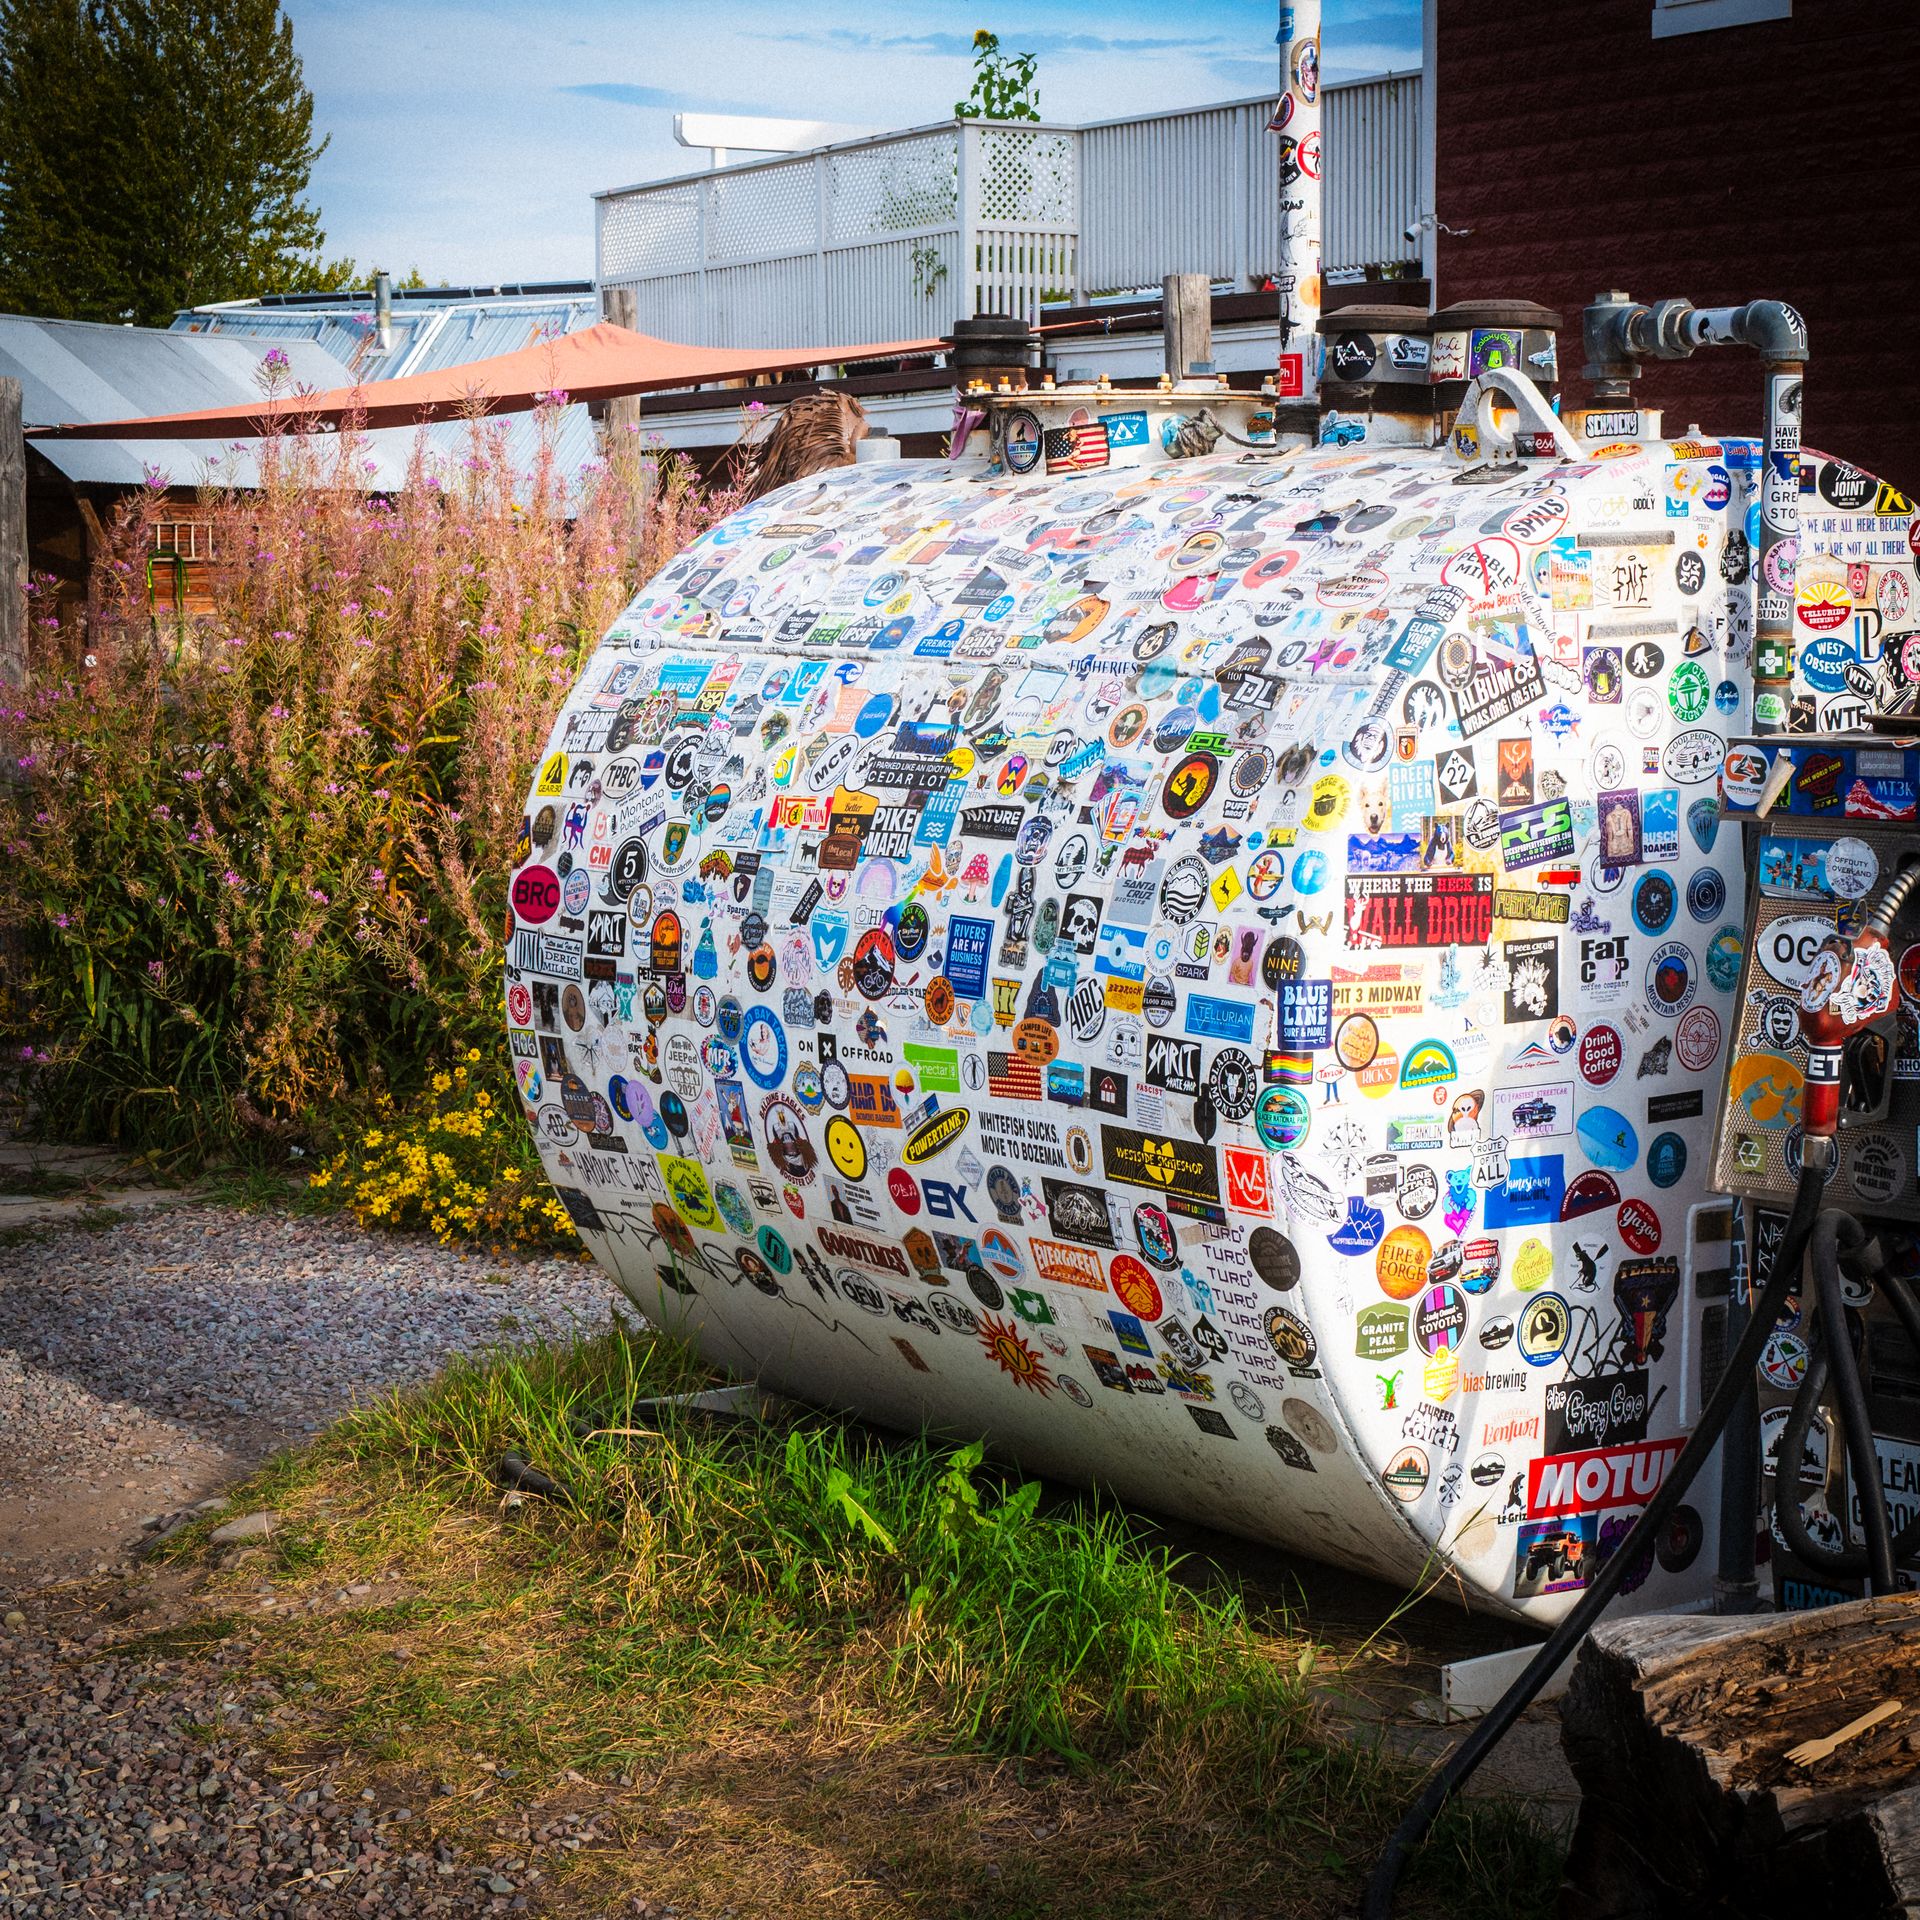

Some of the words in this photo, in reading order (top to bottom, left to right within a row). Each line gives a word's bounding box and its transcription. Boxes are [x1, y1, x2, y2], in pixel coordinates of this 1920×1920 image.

[1775, 427, 1797, 438] HAVE
[1775, 438, 1797, 449] SEEN
[1675, 447, 1723, 460] ADVENTURES
[1835, 464, 1862, 481] The
[1831, 481, 1866, 497] JOINT
[1633, 498, 1655, 510] ODDLY
[1510, 498, 1565, 538] SPILLS
[1807, 520, 1819, 533] WE
[1821, 519, 1837, 533] ARE
[1841, 519, 1853, 533] ALL
[1856, 518, 1876, 532] HERE
[1879, 517, 1911, 532] BECAUSE
[1814, 543, 1825, 555] WE
[1829, 543, 1843, 556] ARE
[1865, 542, 1878, 555] ALL
[1882, 541, 1906, 555] THERE
[1802, 608, 1846, 618] TELLURIDE
[1409, 620, 1442, 637] ELOPE
[1407, 632, 1430, 647] YOUR
[1402, 644, 1424, 658] LIFE
[1817, 642, 1845, 657] WEST
[662, 679, 698, 693] WATERS
[1848, 670, 1873, 691] WTF
[1458, 668, 1513, 716] ALBUM
[1462, 700, 1509, 735] WRAS.ORG
[1529, 679, 1543, 697] FM
[1762, 697, 1775, 705] GO
[1756, 705, 1781, 715] TEAM
[1824, 707, 1866, 730] WTF
[1668, 734, 1688, 754] GOOD
[1689, 732, 1718, 746] PEOPLE
[813, 741, 852, 785] MCB
[876, 760, 900, 770] PARKED
[900, 763, 914, 771] LIKE
[915, 764, 924, 772] AN
[925, 765, 943, 773] IDIOT
[943, 766, 953, 774] IN
[607, 764, 638, 788] TPBC
[868, 772, 913, 785] CEDAR
[919, 775, 947, 787] LOT
[1392, 766, 1433, 782] GREEN
[1446, 765, 1468, 787] 22
[537, 784, 562, 793] GEAR30
[1392, 782, 1432, 799] RIVER
[620, 789, 665, 820] Montana
[926, 796, 960, 813] RIVER
[620, 814, 641, 834] Public
[642, 802, 665, 820] Radio
[875, 808, 916, 830] PIKE
[966, 808, 1021, 825] NATURE
[865, 833, 912, 857] MAFIA
[1643, 831, 1677, 843] BUSCH
[590, 846, 611, 864] CM
[1643, 843, 1678, 853] ROAMER
[623, 848, 639, 877] 5
[1832, 866, 1872, 878] OVERLAND
[515, 881, 559, 902] BRC
[1122, 879, 1156, 891] SANTA
[1346, 878, 1400, 894] WHERE
[1405, 878, 1432, 892] THE
[1437, 877, 1473, 892] HECK
[1478, 877, 1492, 892] IS
[1126, 890, 1154, 900] CRUZ
[727, 905, 749, 916] Spargo
[589, 913, 621, 944] SPIRIT
[1427, 896, 1493, 944] DRUG
[954, 923, 986, 939] RIVERS
[952, 941, 969, 950] ARE
[972, 943, 984, 953] MY
[1653, 948, 1668, 966] SAN
[1669, 943, 1689, 960] DIEGO
[1773, 933, 1818, 967] OG
[544, 952, 577, 965] DERIC
[951, 953, 982, 965] BUSINESS
[1267, 959, 1298, 972] NINE
[543, 961, 579, 977] MILLER
[1176, 965, 1206, 978] SPARK
[1283, 985, 1328, 1005] BLUE
[1333, 989, 1351, 1005] PIT
[1356, 989, 1363, 1003] 3
[1369, 986, 1422, 1003] MIDWAY
[1647, 984, 1675, 1014] MOUNTAIN
[1676, 979, 1696, 1011] RESCUE
[1199, 1005, 1251, 1025] TELLURIAN
[1283, 1006, 1327, 1026] LINE
[1284, 1027, 1299, 1037] SURF
[1307, 1028, 1326, 1037] PADDLE
[1585, 1032, 1614, 1048] Drink
[513, 1033, 537, 1055] 406
[799, 1041, 813, 1052] ON
[841, 1047, 893, 1064] OFFROAD
[668, 1051, 698, 1064] JEEPed
[1149, 1040, 1196, 1078] SPIRIT
[1585, 1047, 1615, 1061] Good
[920, 1062, 949, 1075] nectar
[1319, 1068, 1344, 1078] TAYLOR
[1583, 1057, 1618, 1075] Coffee
[1362, 1070, 1393, 1085] RICK'S
[678, 1083, 697, 1096] 2021
[1136, 1083, 1163, 1096] FASCIST
[978, 1110, 1026, 1137] WHITEFISH
[1027, 1120, 1060, 1144] SUCKS.
[909, 1115, 961, 1160] POWERTANK
[1388, 1142, 1409, 1150] NORTH
[1410, 1140, 1442, 1150] CAROLINA
[1478, 1141, 1502, 1151] ROUTE
[981, 1135, 1005, 1153] MOVE
[1006, 1139, 1019, 1156] TO
[1020, 1142, 1068, 1169] BOZEMAN.
[1116, 1147, 1157, 1164] WESTSIDE
[1157, 1156, 1203, 1174] SKATESHOP
[1480, 1156, 1490, 1165] OF
[1476, 1163, 1506, 1183] ALL
[1618, 1206, 1659, 1242] Yazoo
[1382, 1245, 1413, 1262] FIRE
[1379, 1261, 1425, 1281] FORGE
[1362, 1322, 1405, 1335] GRANITE
[1419, 1313, 1463, 1335] TOYOTAS
[1198, 1328, 1221, 1350] ACE
[1369, 1334, 1396, 1347] PEAK
[1463, 1373, 1484, 1392] bias
[1485, 1369, 1527, 1392] brewing
